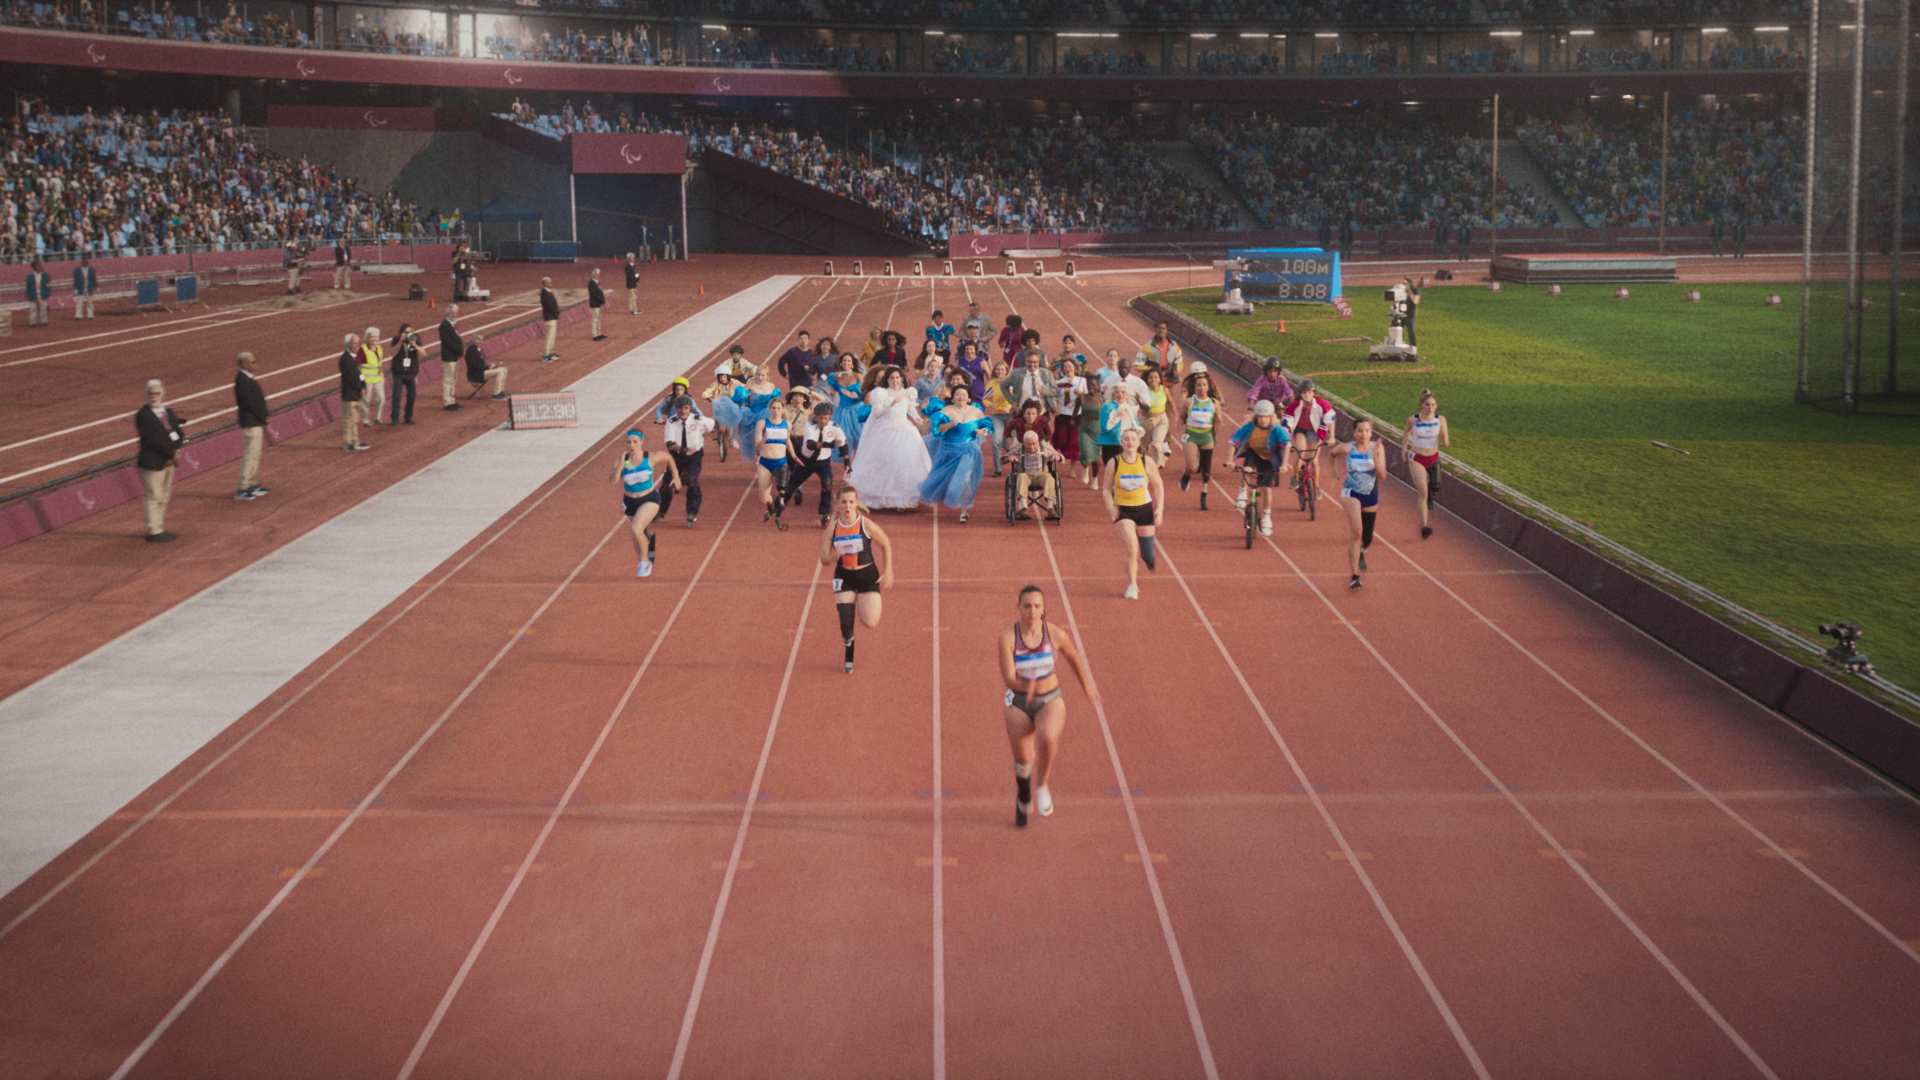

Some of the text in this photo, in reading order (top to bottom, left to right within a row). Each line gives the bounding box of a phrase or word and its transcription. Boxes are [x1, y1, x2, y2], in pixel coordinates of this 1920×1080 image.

[885, 265, 890, 273] 7
[975, 265, 980, 273] 4
[1008, 265, 1013, 273] 3
[1280, 284, 1326, 298] 8.08
[1343, 308, 1351, 316] 77
